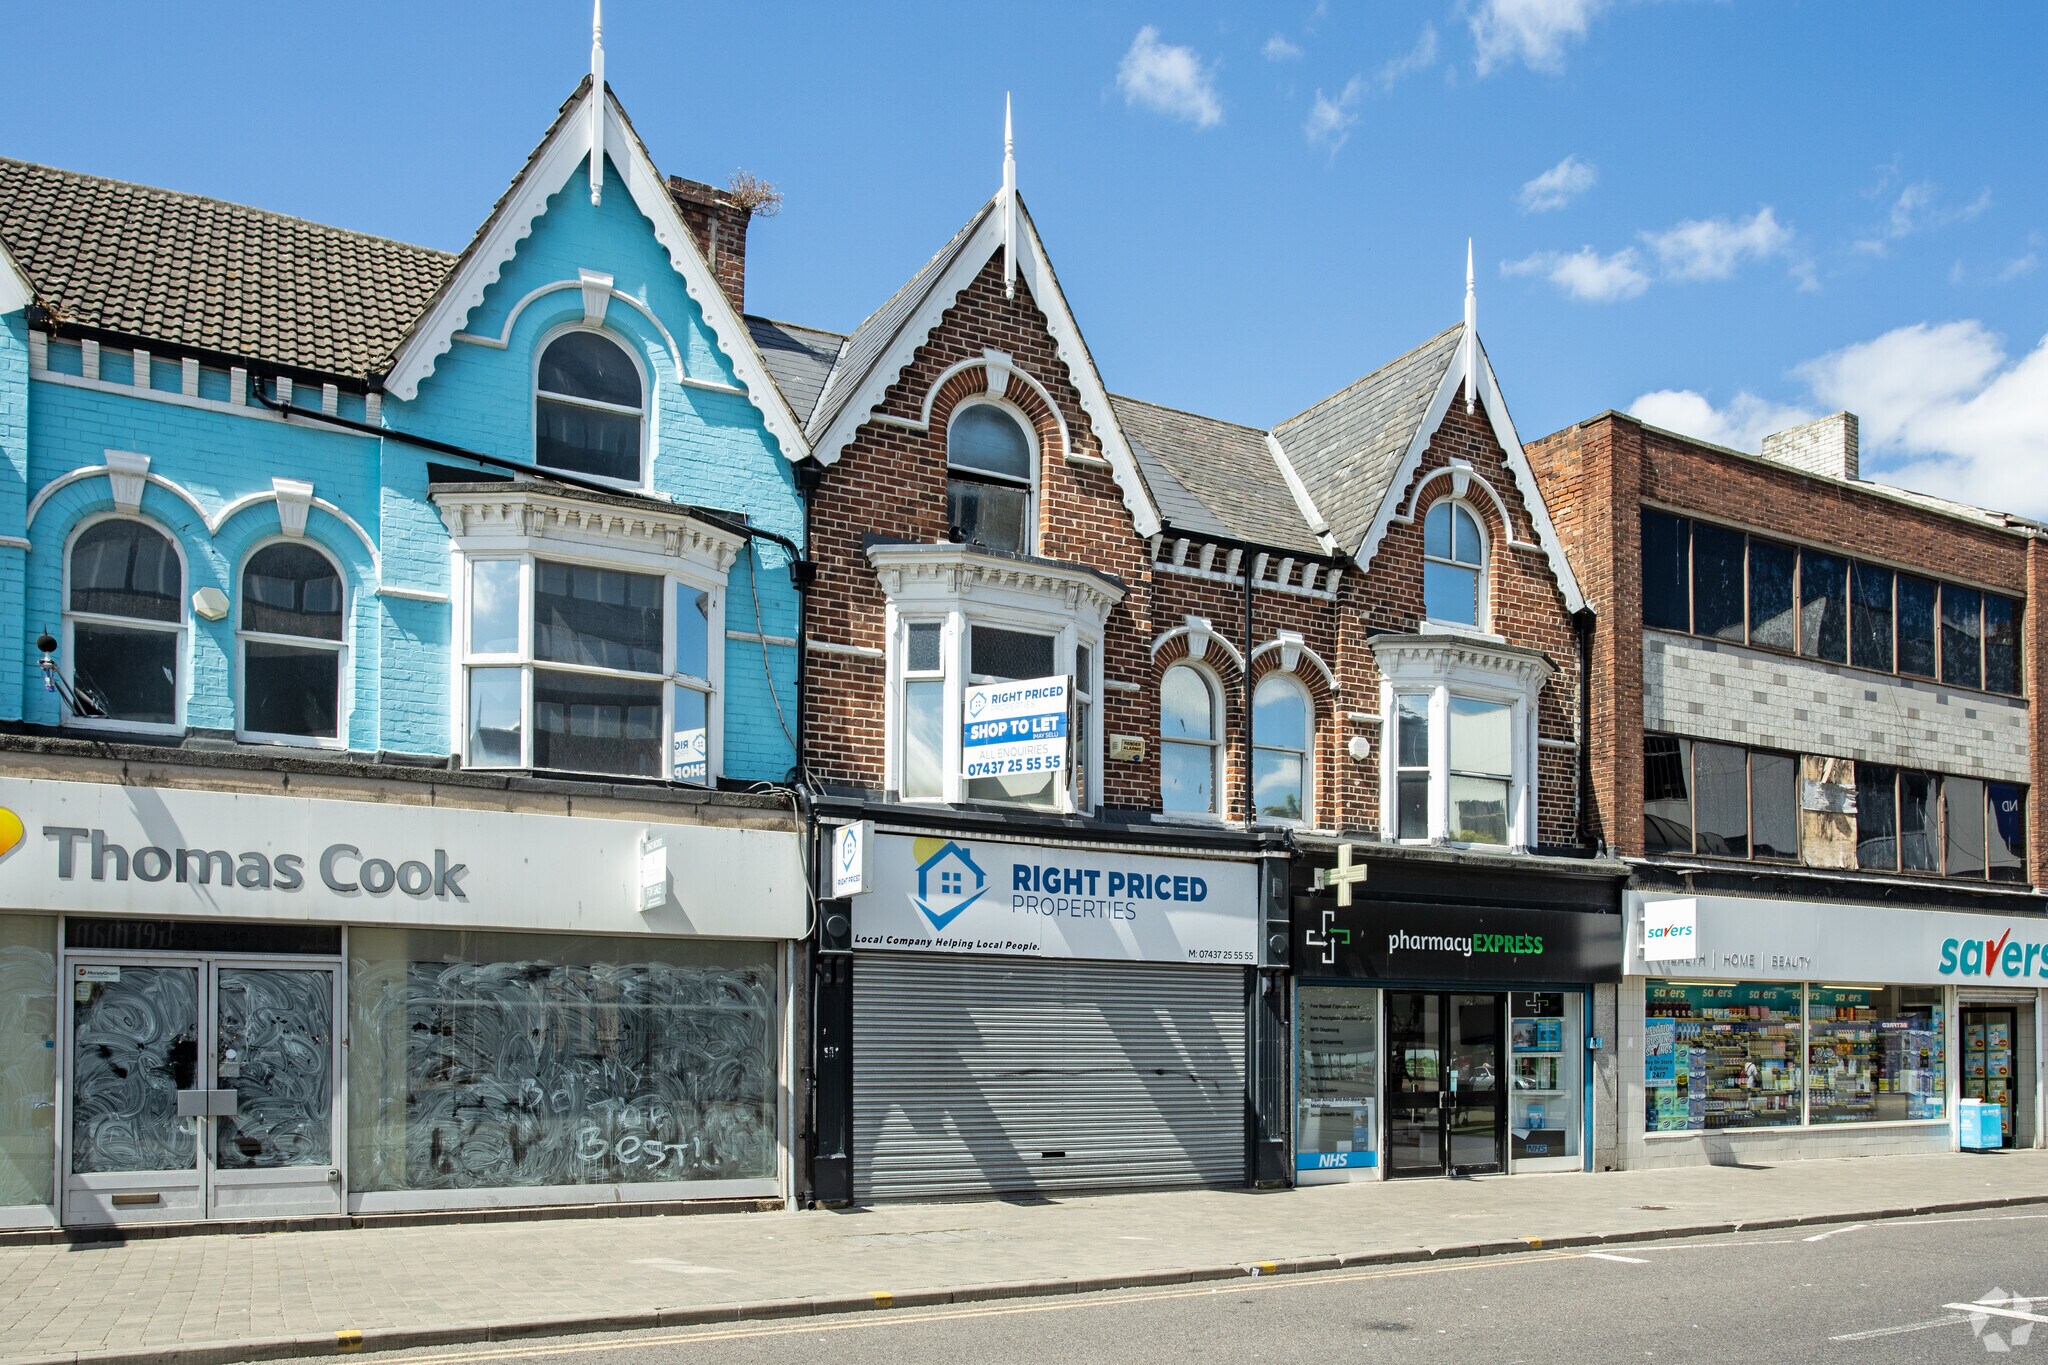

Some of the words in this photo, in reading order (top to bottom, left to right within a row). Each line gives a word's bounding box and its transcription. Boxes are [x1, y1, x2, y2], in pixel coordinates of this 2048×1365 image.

[991, 691, 1022, 704] RIGHT
[1025, 686, 1063, 700] PRICED
[991, 701, 1035, 711] PROPERTIES
[970, 721, 1008, 740] SHOP
[1010, 719, 1029, 735] TO
[1032, 715, 1059, 732] LET
[980, 750, 994, 760] ALL
[997, 744, 1048, 758] ENQUIRIES
[968, 760, 1004, 776] 07437
[1007, 758, 1022, 772] 25
[1026, 757, 1041, 770] 55
[1045, 755, 1060, 769] 55
[43, 826, 303, 889] Thomas
[319, 843, 468, 897] Cook
[1013, 863, 1100, 896] RIGHT
[1108, 871, 1208, 902] PRICED
[1012, 894, 1136, 920] PROPERTIES
[1647, 923, 1692, 938] savers
[854, 934, 883, 944] Local
[886, 935, 932, 948] Company
[935, 938, 973, 949] Helping
[976, 939, 1003, 949] Local
[1005, 941, 1040, 952] People.
[1188, 949, 1198, 958] M:
[1199, 950, 1222, 959] 07437
[1223, 951, 1233, 960] 25
[1234, 951, 1244, 960] 55
[1244, 952, 1254, 960] 55
[1938, 927, 2048, 978] savers
[1723, 953, 1755, 967] HOME
[1771, 955, 1811, 968] BEAUTY
[1654, 988, 1685, 998] savers
[1702, 987, 1732, 998] savers
[1749, 988, 1777, 999] savers
[1792, 990, 1820, 1000] saers
[1527, 1144, 1547, 1152] NHS
[1319, 1153, 1348, 1168] NHS
